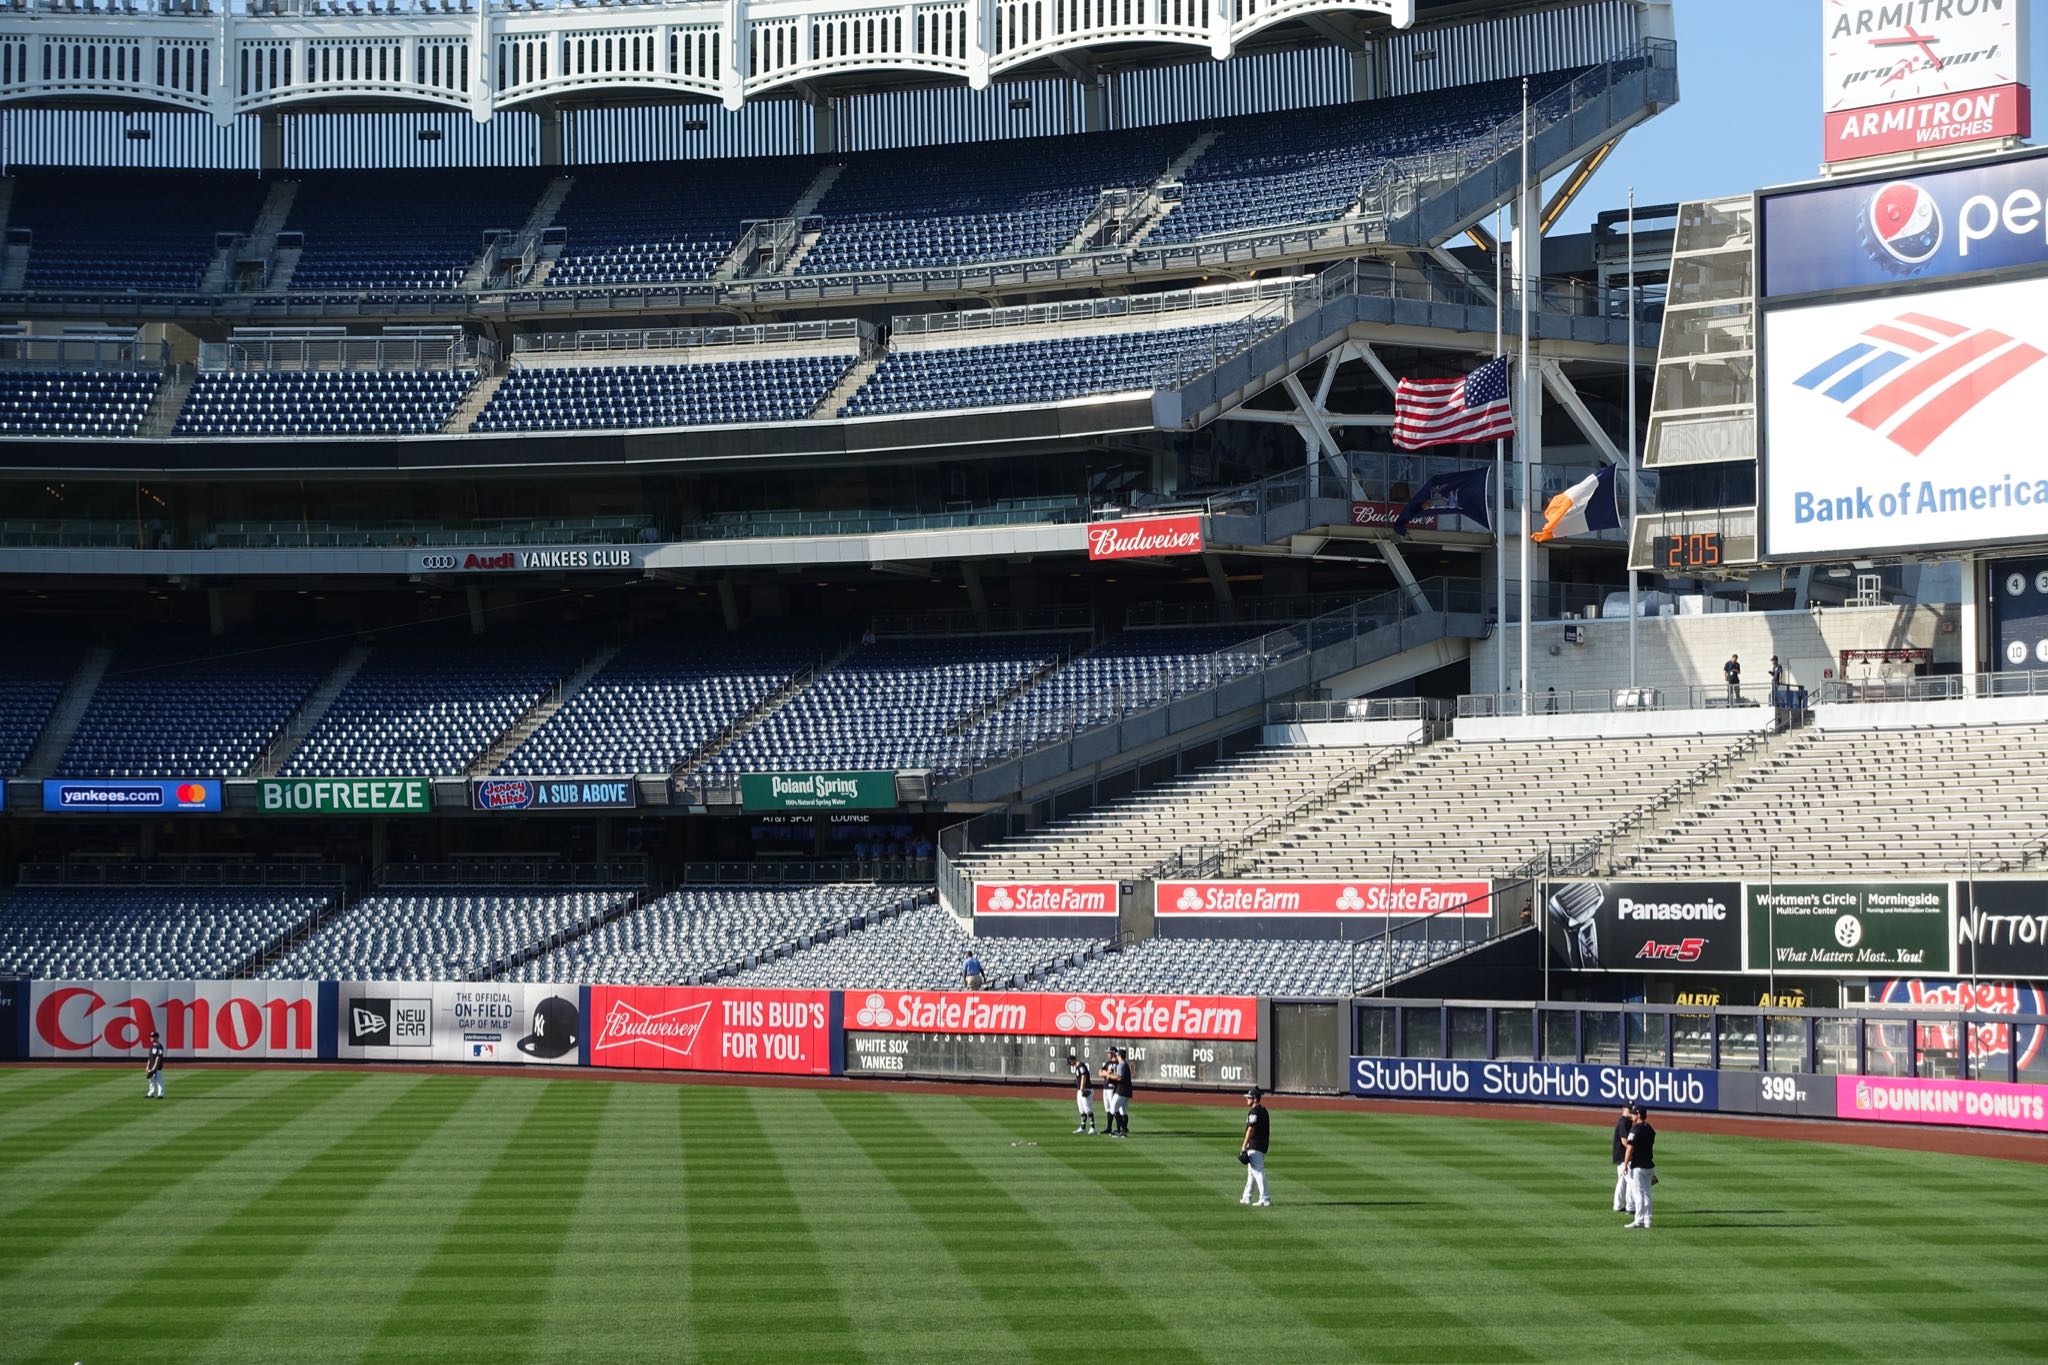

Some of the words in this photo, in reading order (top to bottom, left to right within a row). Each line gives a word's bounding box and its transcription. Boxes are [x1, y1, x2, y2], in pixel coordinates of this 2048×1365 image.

[1840, 93, 1998, 140] ARMITRON
[1916, 118, 1993, 143] WATCHES
[1794, 486, 1874, 524] Bank
[1879, 481, 1911, 517] of
[1916, 473, 2048, 514] America
[1089, 527, 1200, 556] Budweiser
[1669, 533, 1718, 567] 2:05
[463, 553, 514, 570] Audi
[521, 552, 587, 569] YANKEES
[593, 550, 631, 567] CLUB
[2012, 578, 2019, 590] 4
[2012, 646, 2023, 659] 10
[64, 790, 160, 804] yankees.com
[538, 786, 549, 804] A
[551, 785, 579, 804] SUB
[582, 783, 628, 803] ABOVE
[772, 775, 814, 798] Poland
[816, 775, 858, 799] Spring
[1618, 898, 1726, 921] Panasonic
[1756, 893, 1820, 906] Workmen's
[1822, 892, 1857, 906] Circle
[1868, 893, 1940, 907] Morningside
[1776, 907, 1811, 915] MultiCare
[1812, 907, 1838, 916] Center
[1776, 948, 1807, 963] What
[1809, 948, 1854, 963] Matters
[456, 992, 472, 1002] THE
[475, 993, 512, 1003] OFFICIAL
[1676, 992, 1720, 1006] ALEVE
[35, 987, 313, 1051] Canon
[396, 1009, 426, 1022] NEW
[454, 1004, 513, 1018] ON-FIELD
[722, 1000, 764, 1028] THIS
[769, 1002, 825, 1030] BUD'S
[396, 1023, 426, 1037] ERA
[459, 1018, 475, 1029] CAP
[478, 1019, 488, 1029] OF
[490, 1019, 508, 1030] MLB
[606, 1012, 700, 1038] Budweiser
[722, 1033, 759, 1059] FOR
[763, 1034, 807, 1061] YOU.
[855, 1039, 887, 1053] WHITE
[889, 1040, 908, 1054] SOX
[1050, 1046, 1055, 1057] 0
[1084, 1047, 1089, 1058] 0
[1128, 1047, 1147, 1061] BAT
[1192, 1048, 1214, 1063] POS
[860, 1056, 904, 1070] YANKEES
[1050, 1062, 1055, 1073] 0
[1160, 1064, 1196, 1079] STRIKE
[1221, 1066, 1242, 1080] OUT
[1357, 1060, 1470, 1092] StubHub
[1483, 1063, 1590, 1098] StubHub
[1600, 1067, 1704, 1104] StubHub
[1762, 1076, 1796, 1101] 399
[1796, 1091, 1807, 1102] FT
[1873, 1087, 1964, 1114] DUNKIN'
[1965, 1092, 2044, 1120] DONUTS
